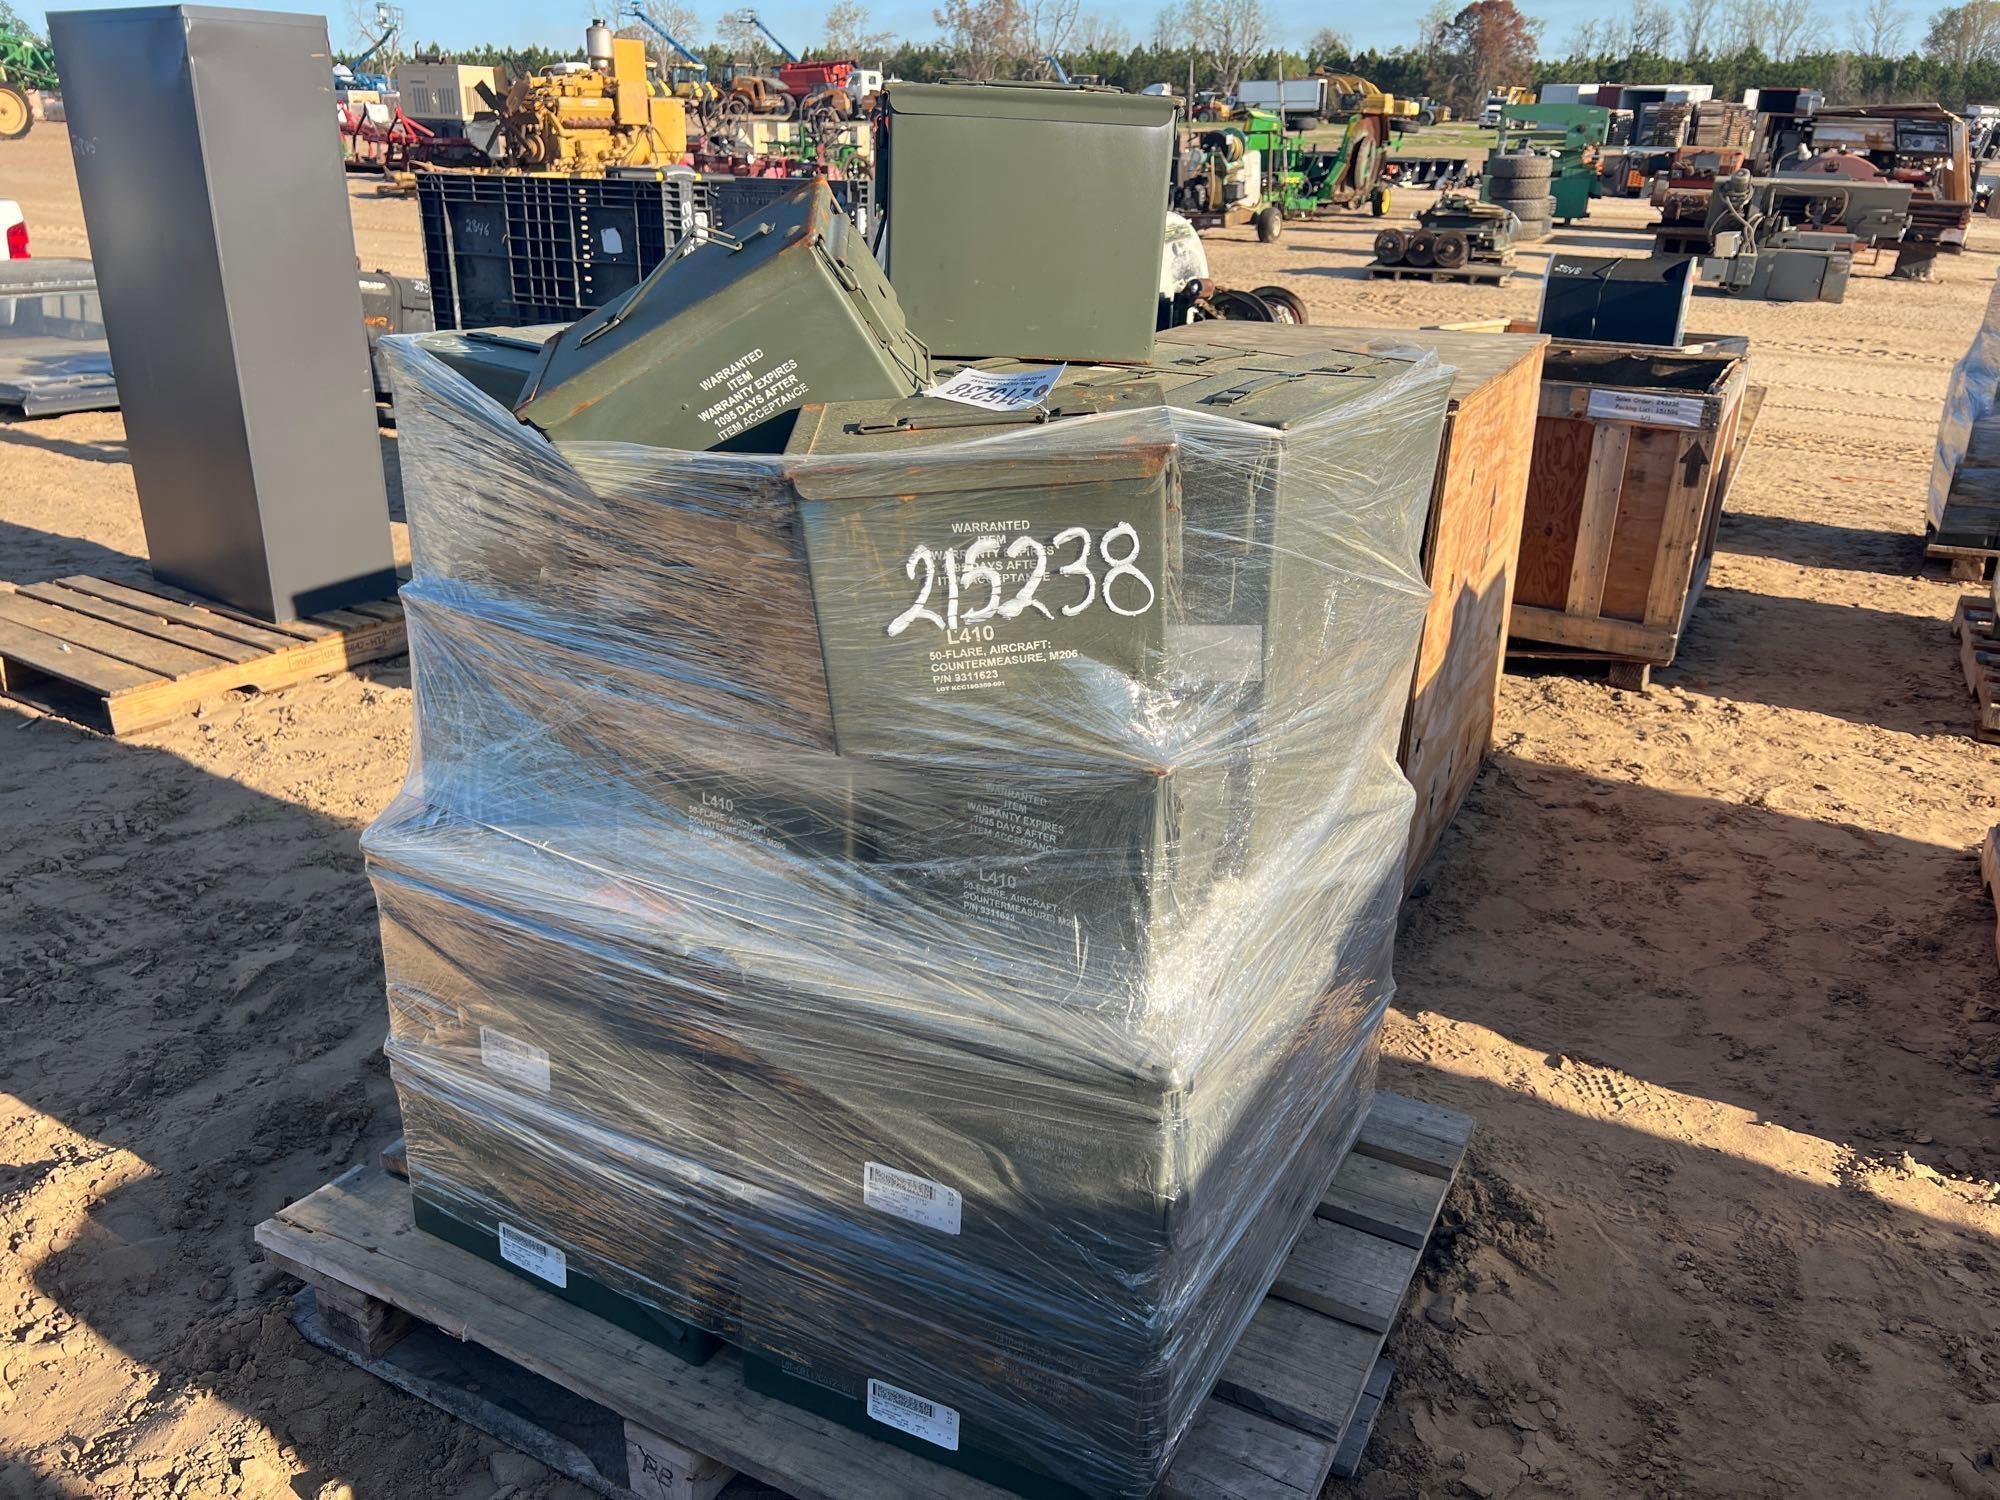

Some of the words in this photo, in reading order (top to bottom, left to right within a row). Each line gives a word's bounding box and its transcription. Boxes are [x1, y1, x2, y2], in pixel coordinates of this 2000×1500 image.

[699, 348, 764, 391] WARRANTED
[726, 370, 754, 391] ITEM
[698, 384, 754, 423] WARRANTY
[754, 359, 798, 390] EXPIRES
[713, 411, 737, 428] 1095
[736, 394, 764, 416] DAYS
[766, 374, 799, 400] AFTER
[946, 383, 1030, 406] 215238
[717, 424, 744, 441] ITEM
[743, 382, 809, 427] ACCEPTANCE
[951, 520, 1031, 534] WARRANTED
[1006, 558, 1043, 571] AFTE
[887, 521, 1155, 637] 215238
[947, 625, 994, 645] L410
[929, 646, 987, 661] 50-FLARE,
[989, 639, 1052, 655] AIRCRAFT:
[931, 652, 1047, 673] COUNTERMEASURE,
[1049, 649, 1078, 661] M206
[932, 673, 952, 684] P/N
[936, 685, 950, 693] LOT
[702, 792, 734, 812] L410
[985, 783, 1049, 807] WARRANTED
[967, 801, 1021, 823] WARRANTY
[1023, 816, 1065, 834] EXPIRES
[1003, 800, 1027, 814] ITEM
[969, 824, 992, 838] ITEM
[973, 814, 995, 828] 1095
[996, 821, 1022, 835] DAYS
[1024, 828, 1057, 844] AFTER
[979, 867, 1017, 889] L410
[963, 901, 978, 913] P/N
[1009, 893, 1061, 913] AIRCRAFT:
